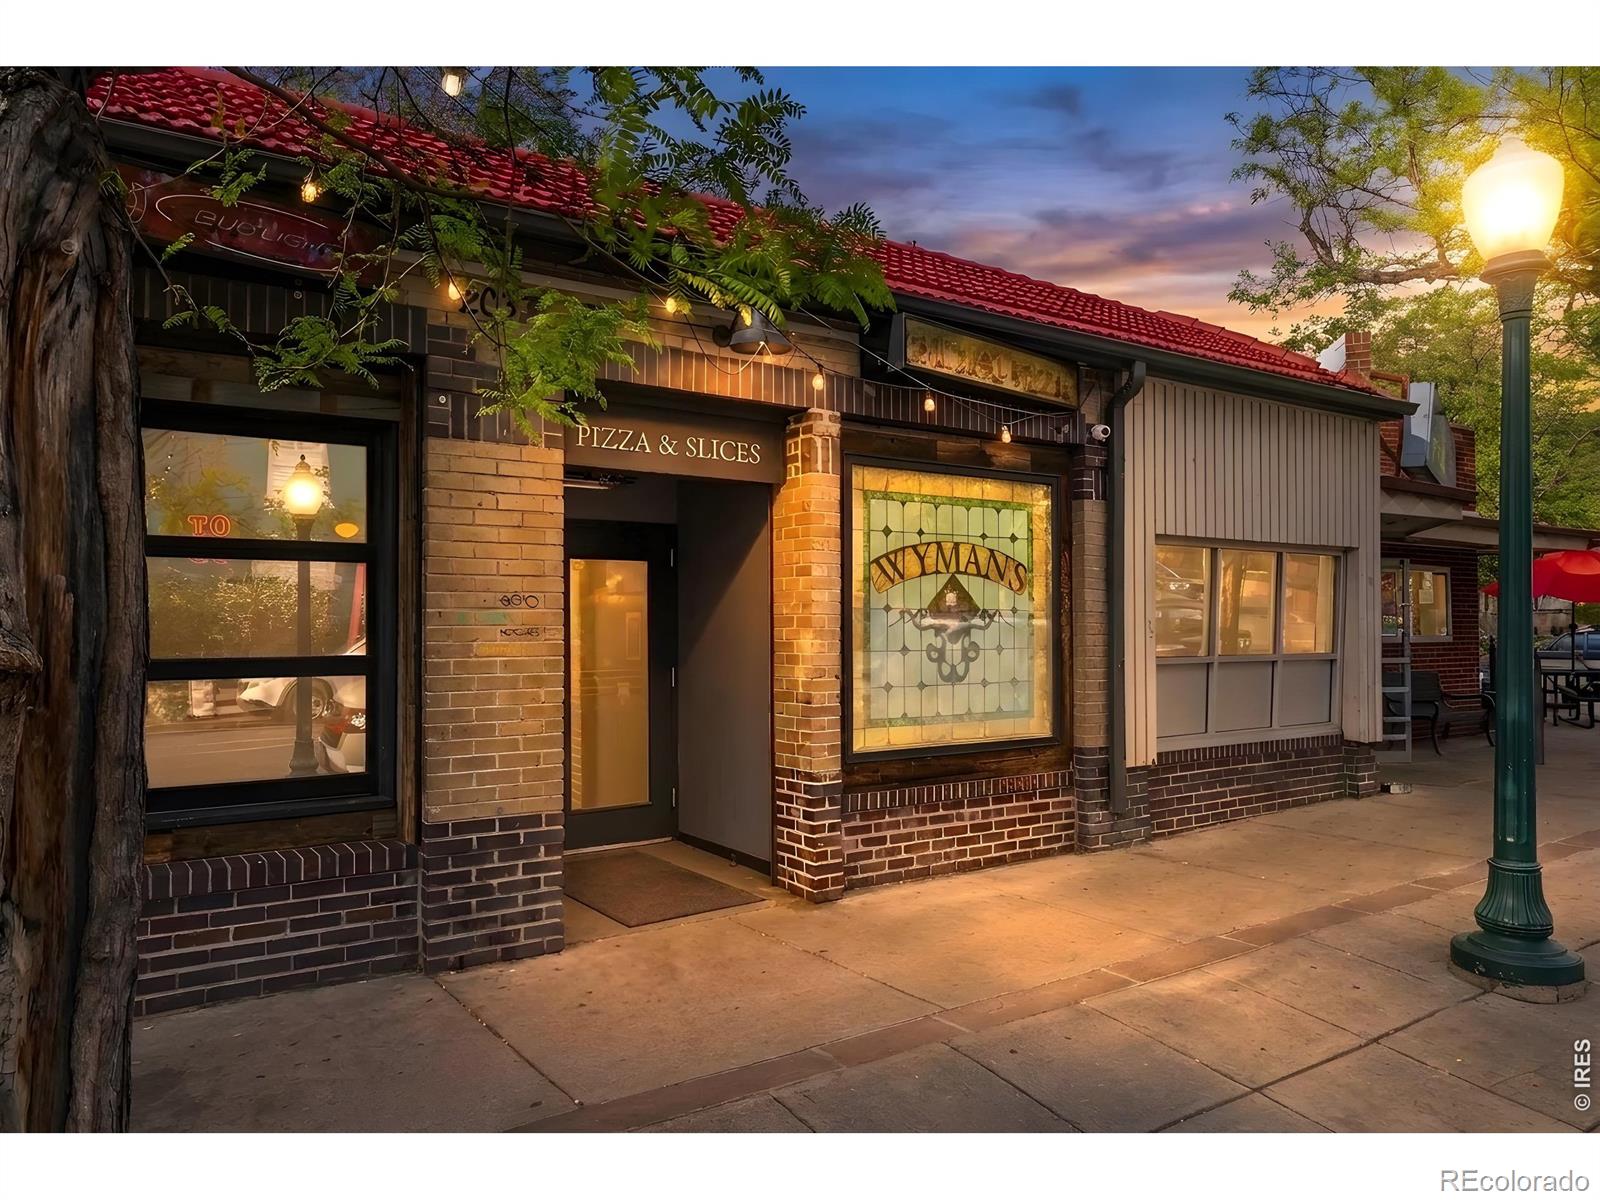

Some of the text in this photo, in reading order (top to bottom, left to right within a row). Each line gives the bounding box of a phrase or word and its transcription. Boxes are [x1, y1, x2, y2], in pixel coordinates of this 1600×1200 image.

[575, 425, 761, 464] PIZZA & SLICES
[188, 515, 230, 537] TO
